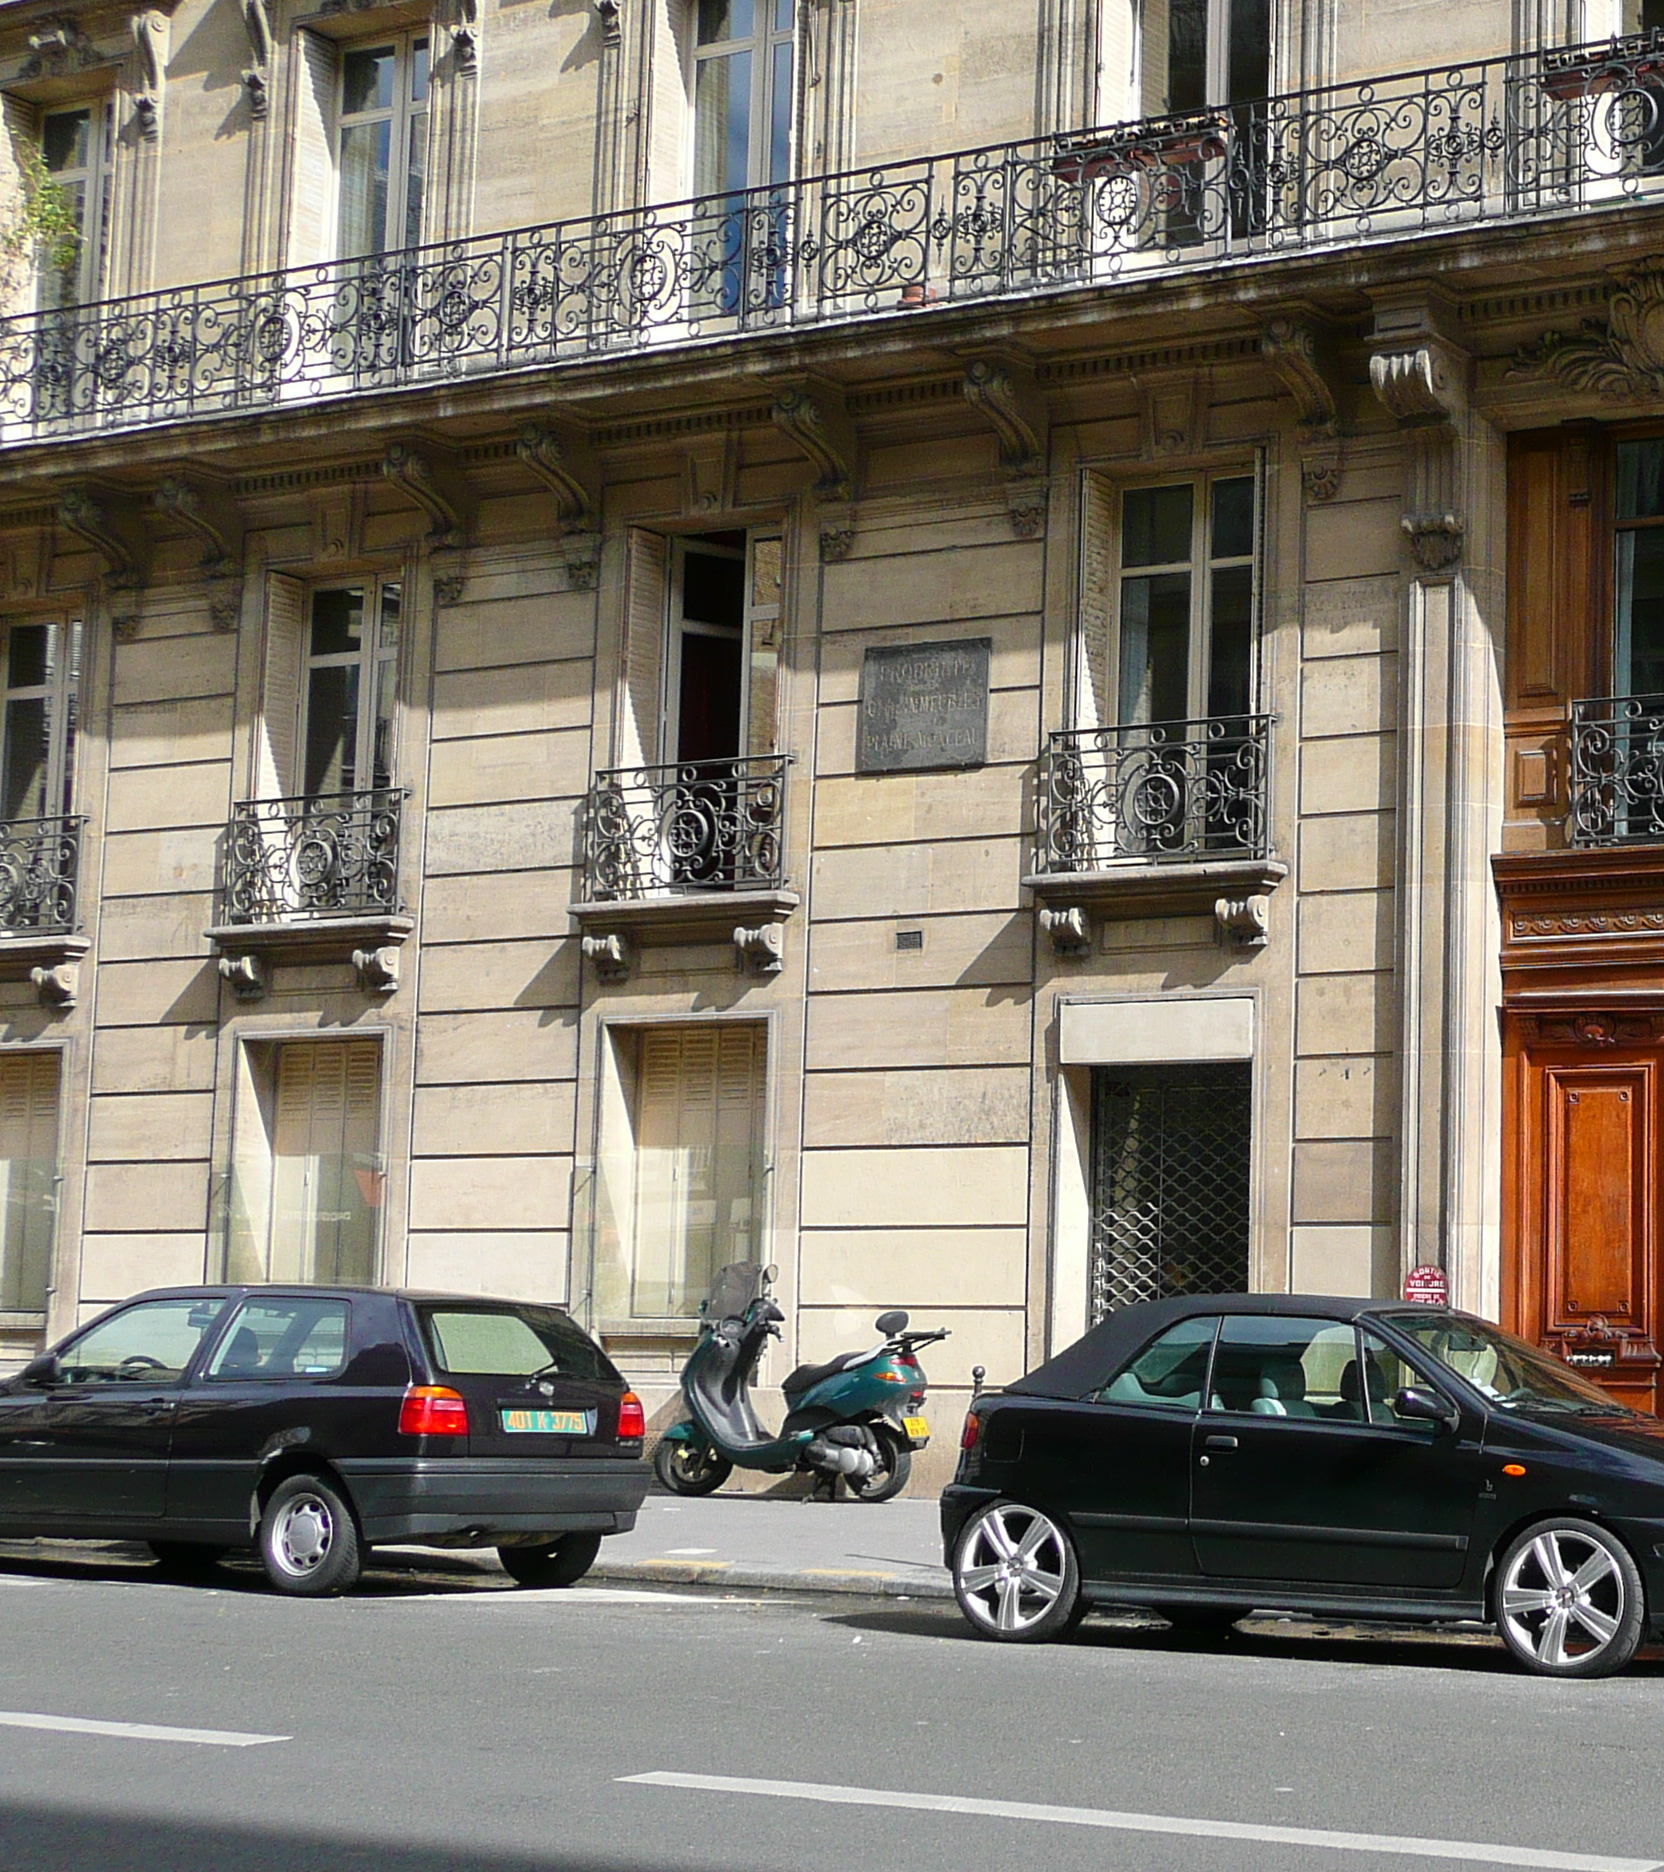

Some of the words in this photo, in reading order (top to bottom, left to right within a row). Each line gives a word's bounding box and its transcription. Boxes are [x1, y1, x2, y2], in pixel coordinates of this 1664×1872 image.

[1409, 1279, 1445, 1288] VOIURE
[507, 1410, 532, 1429] 401
[537, 1411, 547, 1429] K
[551, 1411, 583, 1431] 3775
